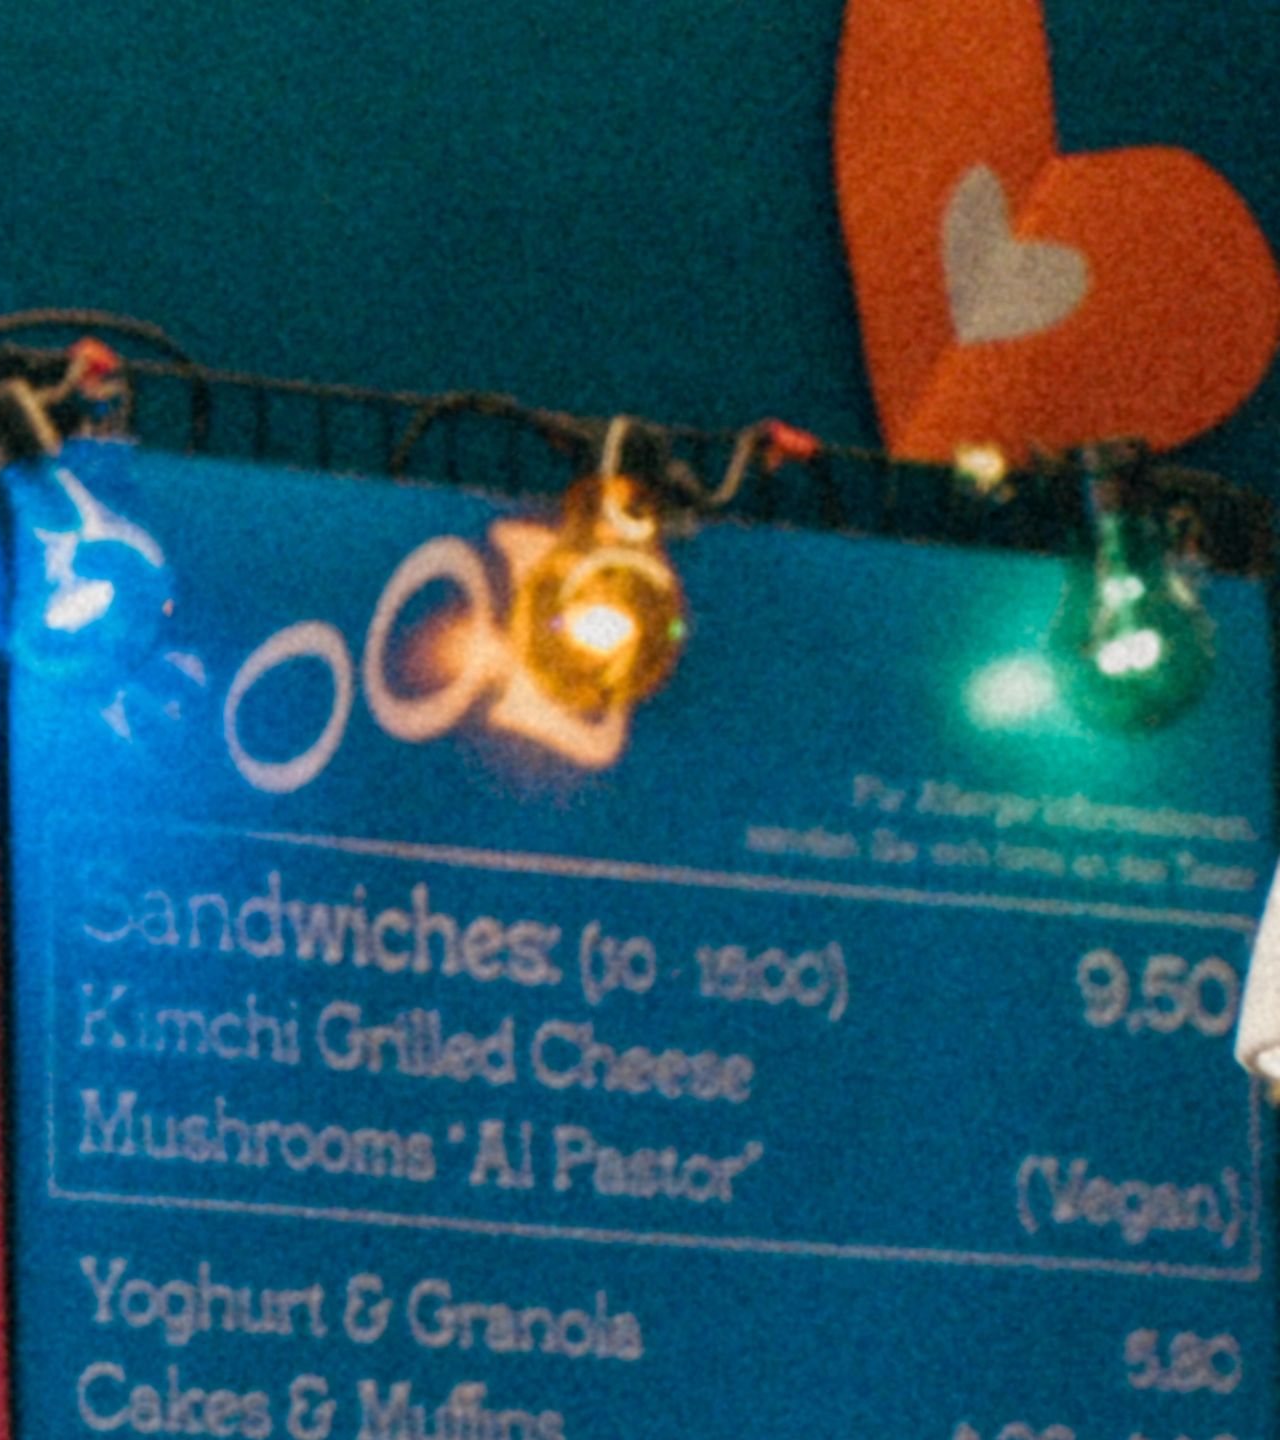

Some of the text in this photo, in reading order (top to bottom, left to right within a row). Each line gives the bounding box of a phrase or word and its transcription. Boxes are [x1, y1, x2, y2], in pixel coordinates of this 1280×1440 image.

[80, 981, 756, 1104] Kimchi Grilled Cheese
[1076, 947, 1241, 1036] 9,50
[79, 1088, 438, 1183] Mushrooms
[1015, 1154, 1243, 1250] (Vegan)
[79, 1254, 329, 1347] Yoghurt
[344, 1272, 394, 1344] &
[407, 1277, 645, 1362] Granola
